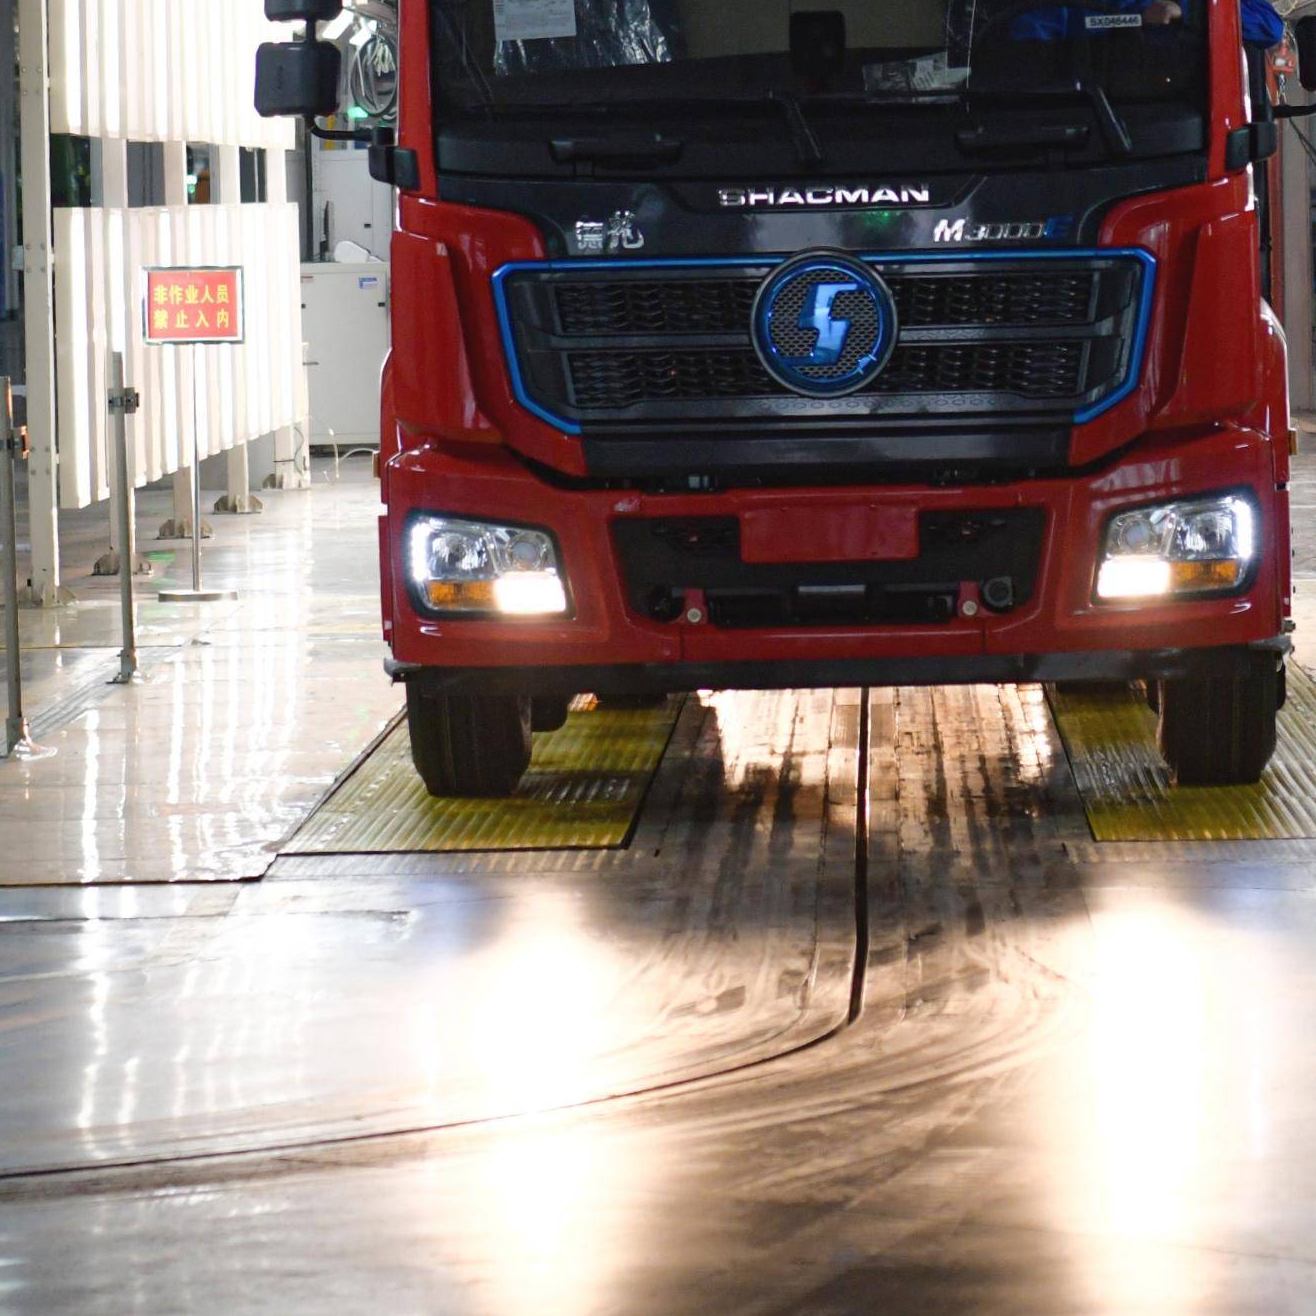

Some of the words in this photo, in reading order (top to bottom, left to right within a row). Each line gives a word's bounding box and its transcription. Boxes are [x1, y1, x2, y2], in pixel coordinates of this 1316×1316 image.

[718, 186, 930, 205] SHACMAN
[153, 284, 230, 305] 非作业人员
[154, 309, 230, 329] 禁止入内
